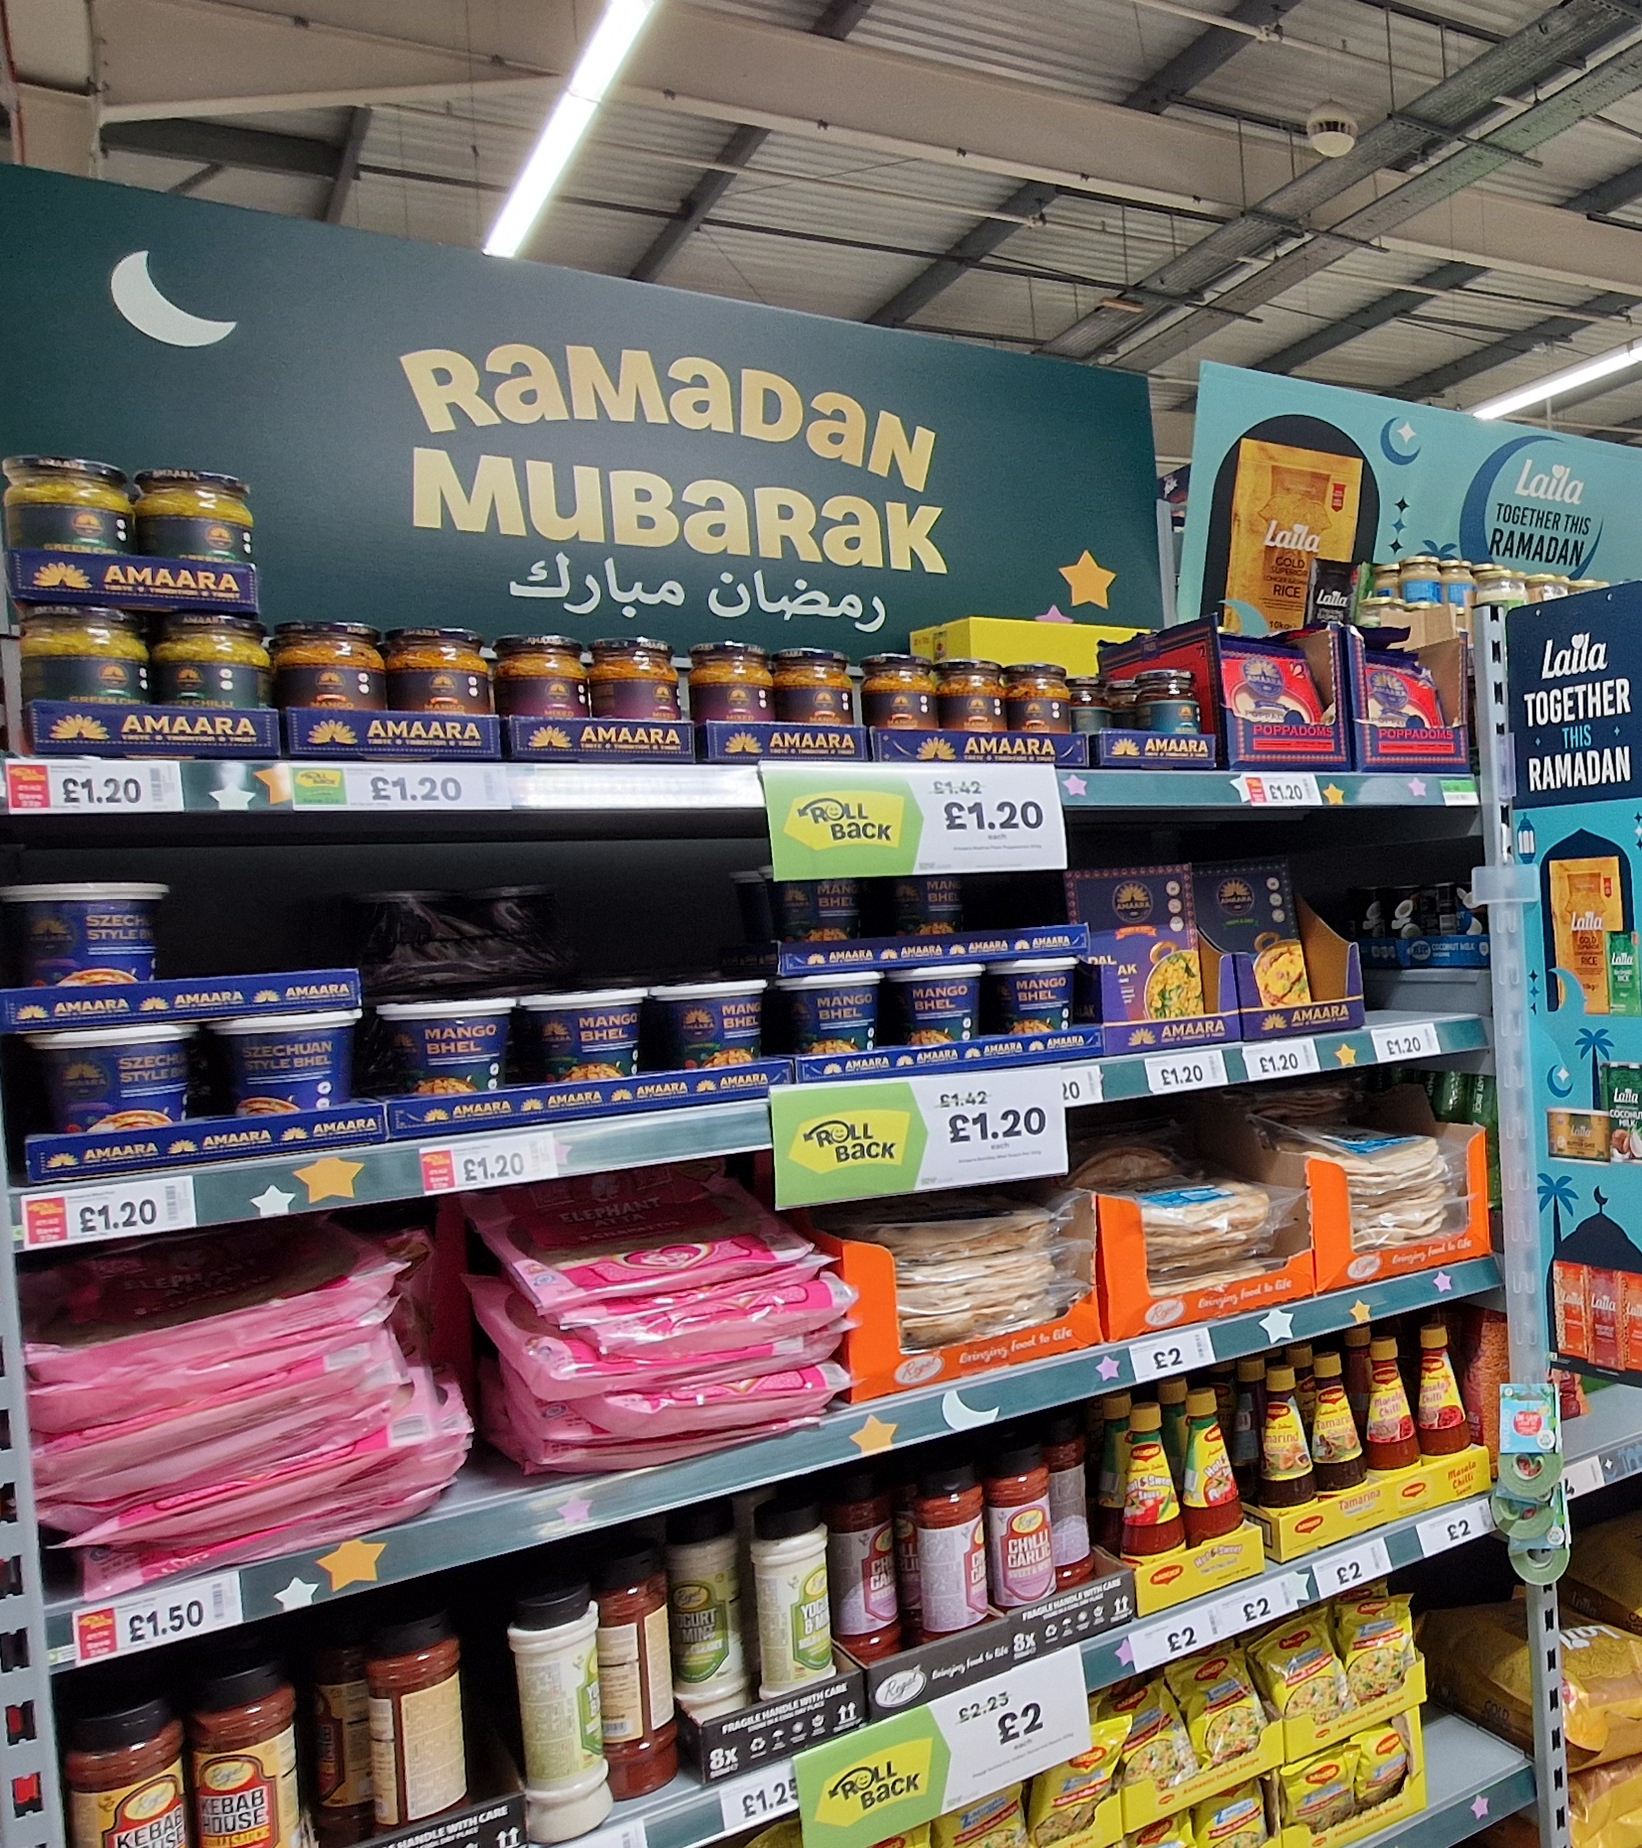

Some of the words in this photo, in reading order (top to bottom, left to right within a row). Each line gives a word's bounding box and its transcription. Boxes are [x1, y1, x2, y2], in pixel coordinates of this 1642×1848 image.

[1513, 457, 1586, 505] Laila
[1495, 501, 1562, 532] TOGETHER
[1563, 512, 1591, 536] THIS
[1263, 520, 1322, 553] Laila
[1488, 526, 1585, 568] RAMADAN
[1275, 556, 1306, 569] GOLD
[104, 564, 241, 593] AMAARA
[508, 550, 686, 618] مبارك
[707, 569, 886, 632] رمضان
[1273, 584, 1302, 598] RICE
[1315, 588, 1348, 608] Laila
[1541, 631, 1609, 681] Laila
[1523, 677, 1632, 728] TOGETHER
[121, 714, 257, 738] AMAARA
[367, 720, 482, 741] AMAARA
[580, 727, 681, 745] AMAARA
[1253, 724, 1335, 738] POPPADOMS
[1378, 727, 1455, 741] POPPADOMS
[1561, 723, 1592, 750] THIS
[769, 732, 856, 750] AMAARA
[964, 736, 1056, 756] AMAARA
[1144, 738, 1209, 754] AMAARA
[1528, 745, 1632, 792] RAMADAN
[62, 778, 142, 804] £1.20
[370, 777, 462, 802] £1.20
[933, 780, 983, 795] £1.42
[1269, 783, 1304, 801] £1.20
[810, 801, 869, 824] ROLL
[944, 801, 1043, 831] £1.20
[1570, 911, 1604, 932] Laila
[87, 929, 136, 941] STYLE
[285, 982, 350, 1000] AMAARA
[911, 984, 968, 999] MANGO
[1015, 976, 1067, 990] MANGO
[174, 990, 244, 1007] AMAARA
[816, 994, 873, 1008] MANGO
[914, 998, 956, 1011] BHEL
[1017, 989, 1057, 1001] BHEL
[53, 997, 130, 1016] AMAARA
[818, 1007, 862, 1020] BHEL
[578, 1012, 638, 1029] MANGO
[722, 1016, 759, 1030] BHEL
[424, 1024, 496, 1041] MANGO
[580, 1027, 629, 1042] BHEL
[242, 1041, 333, 1059] SZECHUAN
[426, 1041, 483, 1056] BHEL
[1386, 1036, 1422, 1056] £1.20
[245, 1057, 290, 1070] STYLE
[292, 1053, 333, 1068] BHEL
[1259, 1052, 1299, 1073] £1.20
[120, 1070, 169, 1083] STYLE
[1160, 1064, 1204, 1086] £1.20
[939, 1091, 988, 1108] £1.42
[1613, 1087, 1639, 1105] Laila
[452, 1099, 512, 1118] AMAARA
[312, 1117, 378, 1134] AMAARA
[816, 1122, 874, 1148] ROLL
[948, 1107, 1047, 1144] £1.20
[202, 1129, 273, 1147] AMAARA
[83, 1142, 159, 1161] AMAARA
[463, 1152, 525, 1182] £1.20
[79, 1199, 158, 1234] £1.20
[559, 1197, 661, 1223] ELEPHANT
[1011, 1336, 1036, 1352] food
[1039, 1332, 1050, 1343] to
[1052, 1327, 1073, 1341] life
[1152, 1347, 1183, 1370] £2
[1447, 1460, 1477, 1481] Masala
[1452, 1473, 1474, 1489] Chilli
[1446, 1519, 1472, 1541] £2
[1008, 1531, 1049, 1558] CHILLI
[1007, 1545, 1052, 1569] GARLIC
[1335, 1562, 1361, 1585] £2
[1242, 1597, 1271, 1621] £2
[128, 1600, 204, 1643] £1.50
[1012, 1632, 1036, 1652] 8x
[1167, 1626, 1198, 1652] £2
[721, 1711, 763, 1736] FRAGILE
[761, 1700, 800, 1721] HANDLE
[799, 1692, 824, 1711] WITH
[824, 1682, 849, 1699] CARE
[958, 1692, 1010, 1721] £2.25
[997, 1703, 1044, 1745] £2
[709, 1747, 738, 1771] 8x
[841, 1762, 896, 1799] ROLL
[201, 1788, 265, 1815] KEBAB
[742, 1777, 798, 1819] £1.25
[115, 1807, 184, 1848] KEBAB
[202, 1811, 267, 1836] HOUSE
